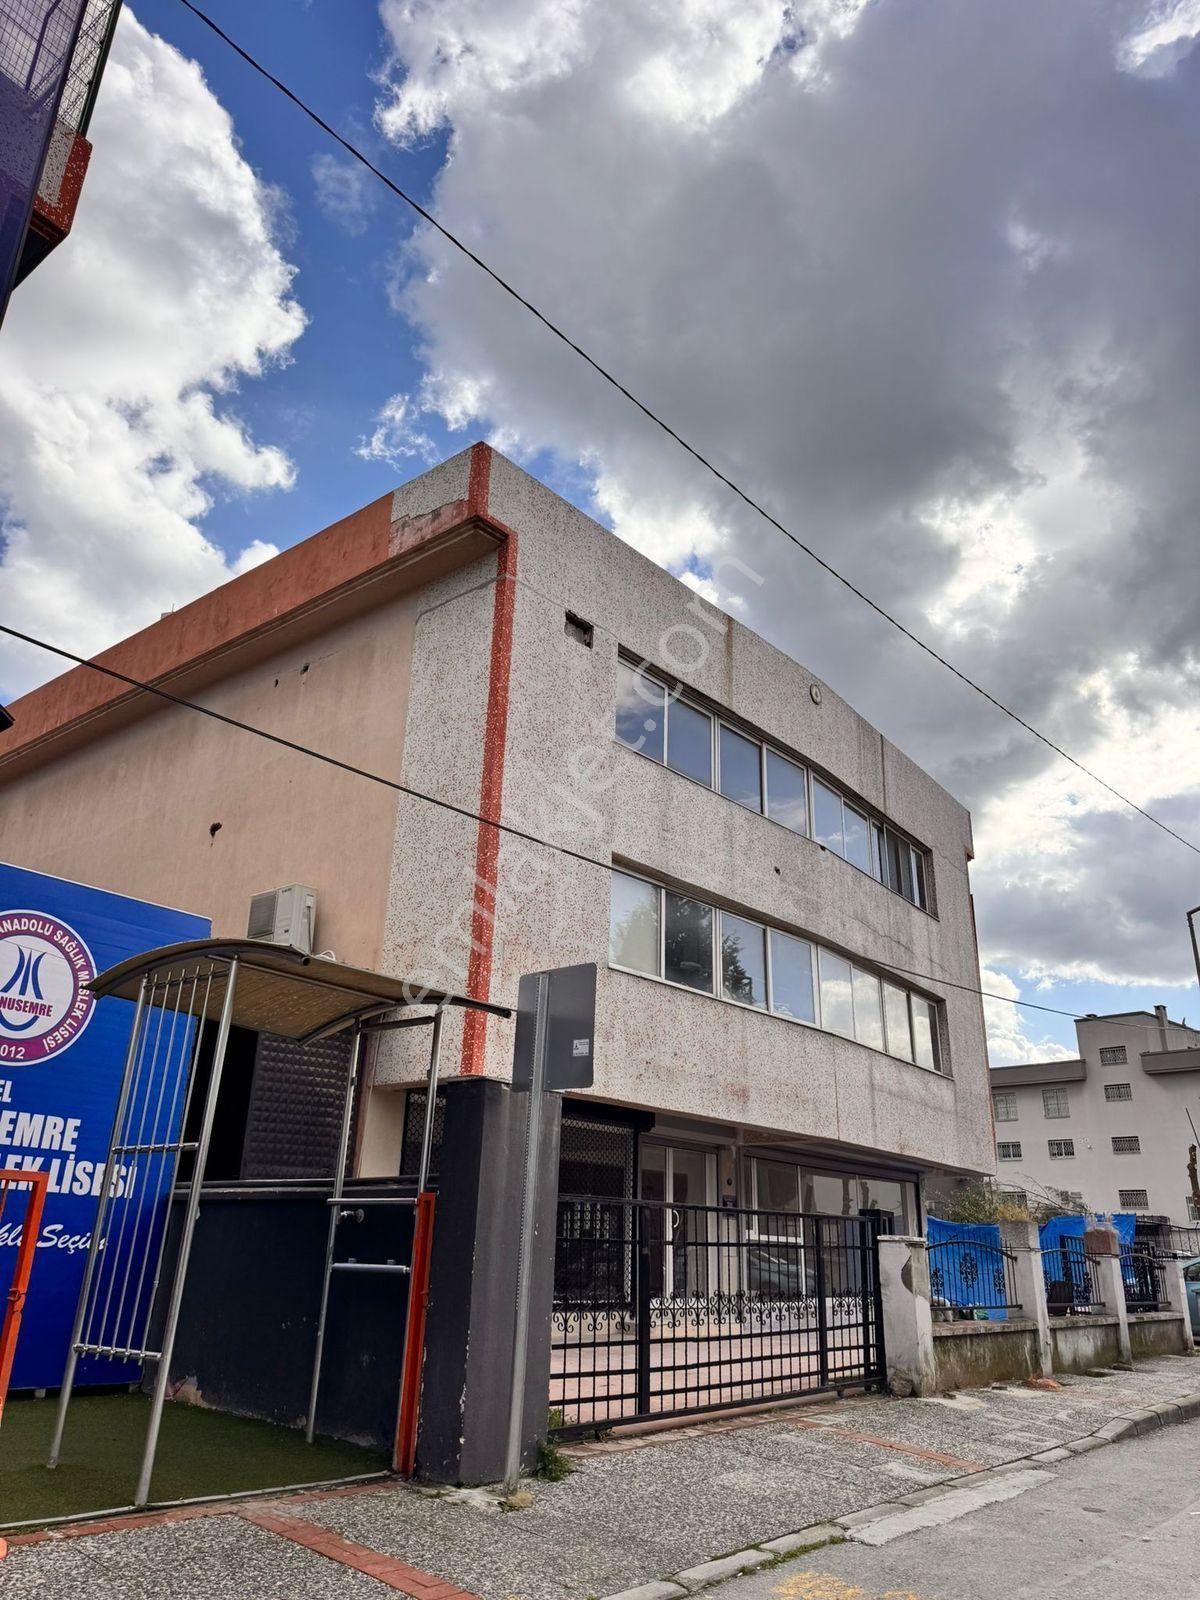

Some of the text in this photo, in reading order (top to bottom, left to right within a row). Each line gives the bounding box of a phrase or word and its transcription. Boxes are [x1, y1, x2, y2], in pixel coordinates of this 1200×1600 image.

[53, 930, 87, 969] SAĞLIK
[71, 970, 90, 1020] MESLEK
[43, 1018, 78, 1053] LİSESİ
[0, 1109, 82, 1152] EMRE
[0, 1152, 45, 1191] EK
